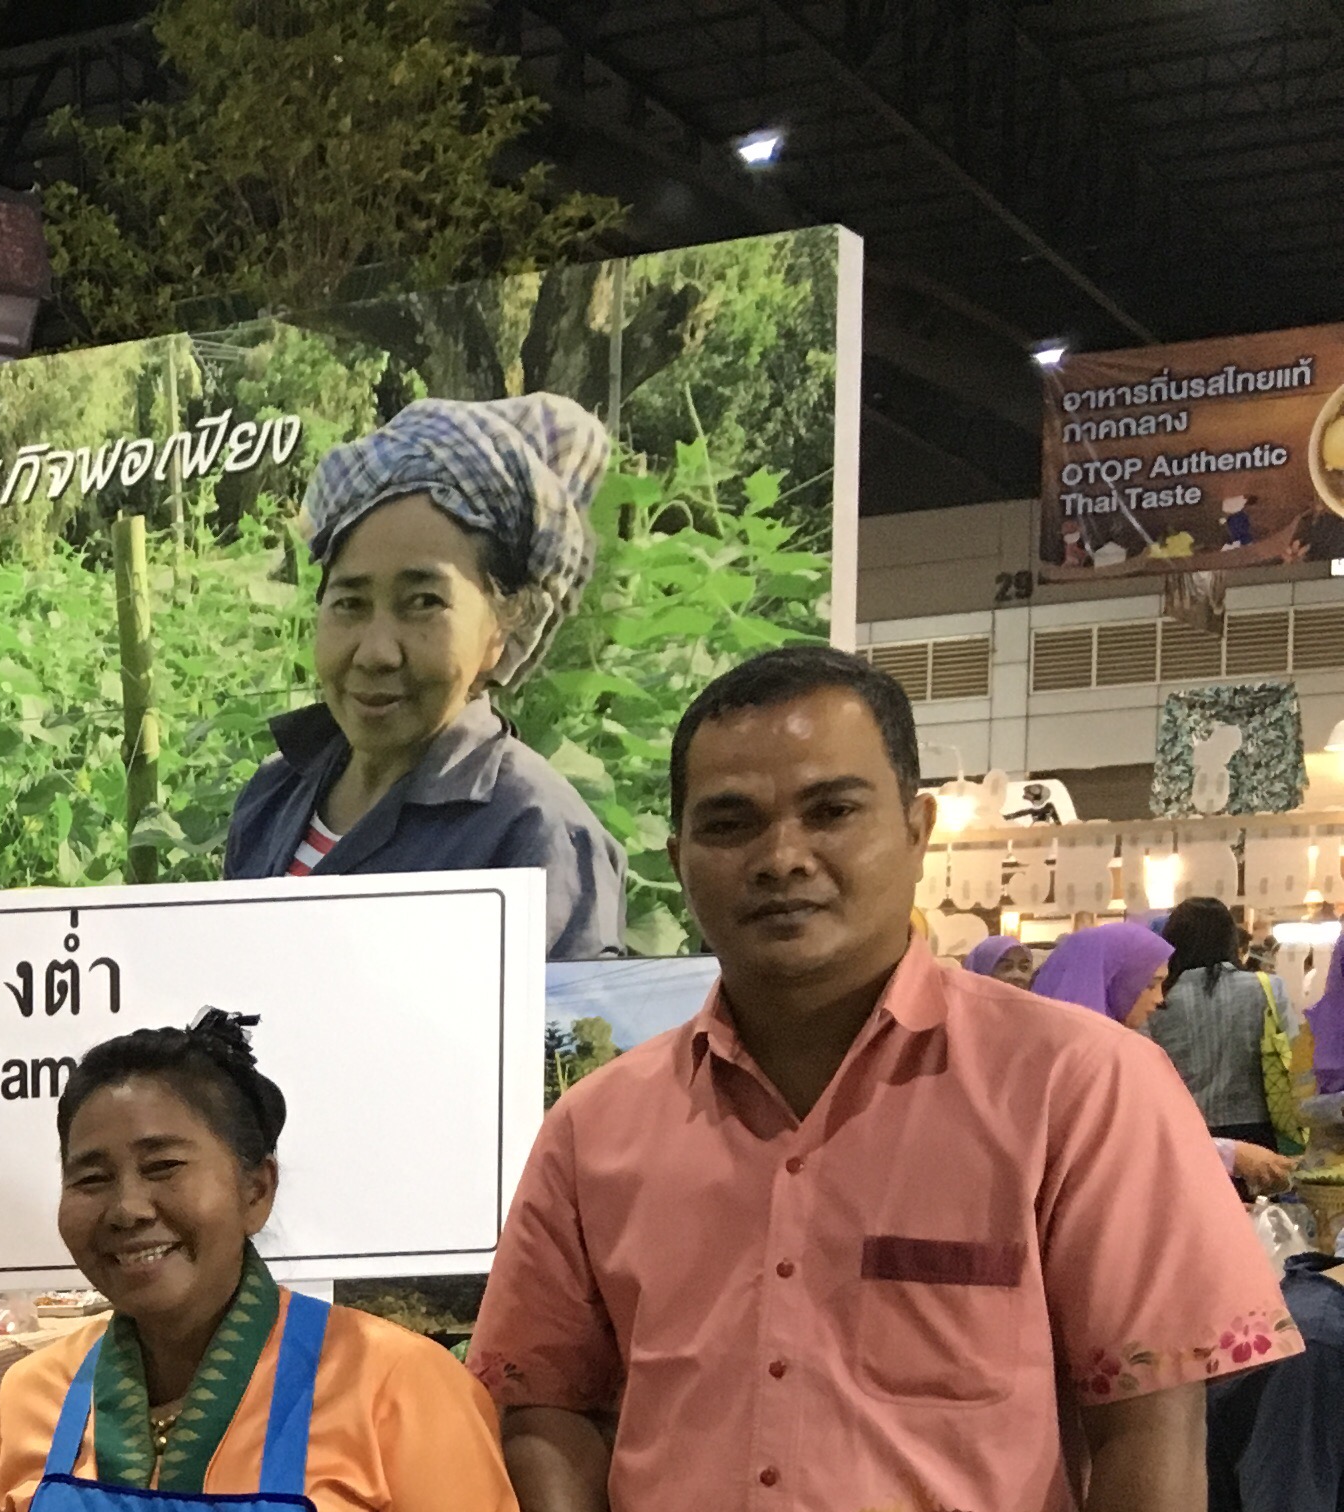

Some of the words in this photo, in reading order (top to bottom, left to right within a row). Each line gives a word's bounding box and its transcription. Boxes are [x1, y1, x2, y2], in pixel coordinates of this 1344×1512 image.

[1063, 357, 1312, 412] อาหารถิ่นรสไทยแท้
[1062, 411, 1188, 444] ภาคกลาง
[1061, 458, 1143, 487] OTOP
[1149, 444, 1288, 479] Authentic
[1060, 491, 1118, 516] Thai
[1125, 483, 1203, 510] Taste
[994, 570, 1034, 602] 29
